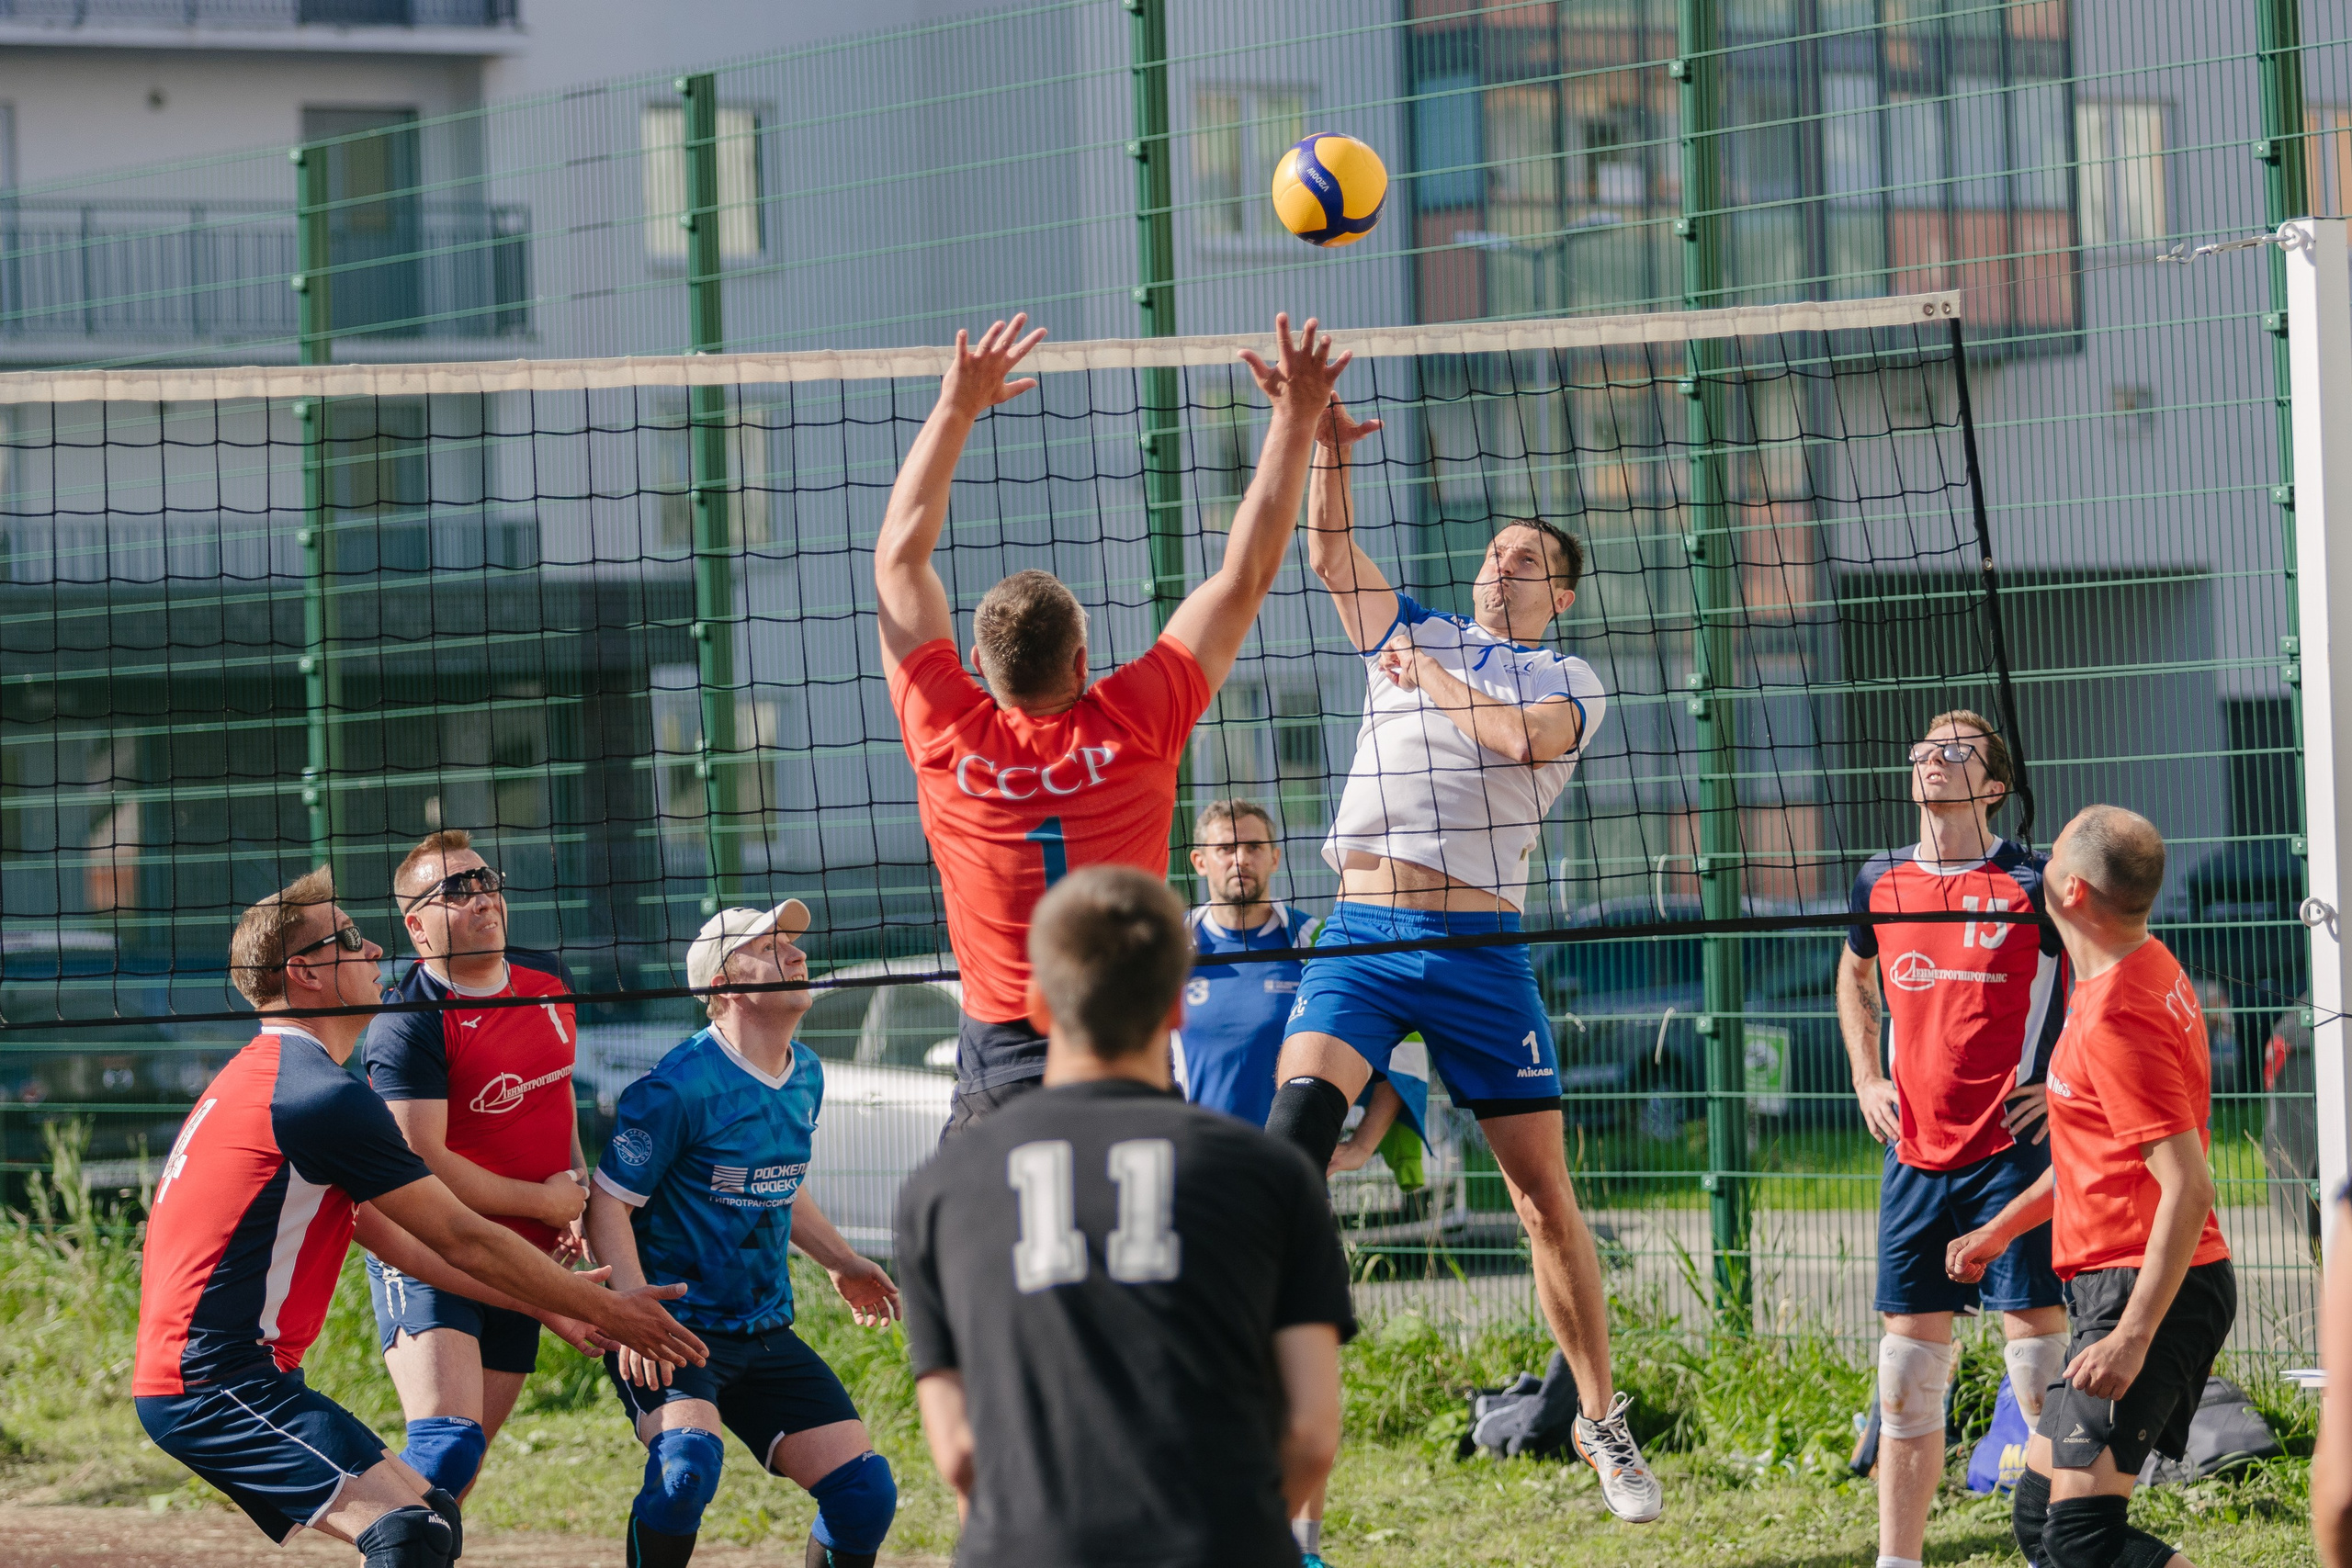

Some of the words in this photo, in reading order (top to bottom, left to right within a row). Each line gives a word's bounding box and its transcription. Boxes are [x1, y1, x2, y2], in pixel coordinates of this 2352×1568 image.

[1306, 167, 1329, 192] V200W
[956, 747, 1115, 800] СССР
[1024, 815, 1068, 892] 1
[1962, 896, 2009, 950] 15
[1186, 976, 1209, 1006] 3
[1521, 1031, 1541, 1064] 1
[750, 1177, 798, 1194] ПРОЕКТ
[1007, 1137, 1182, 1296] 11
[448, 1417, 472, 1427] TORRES
